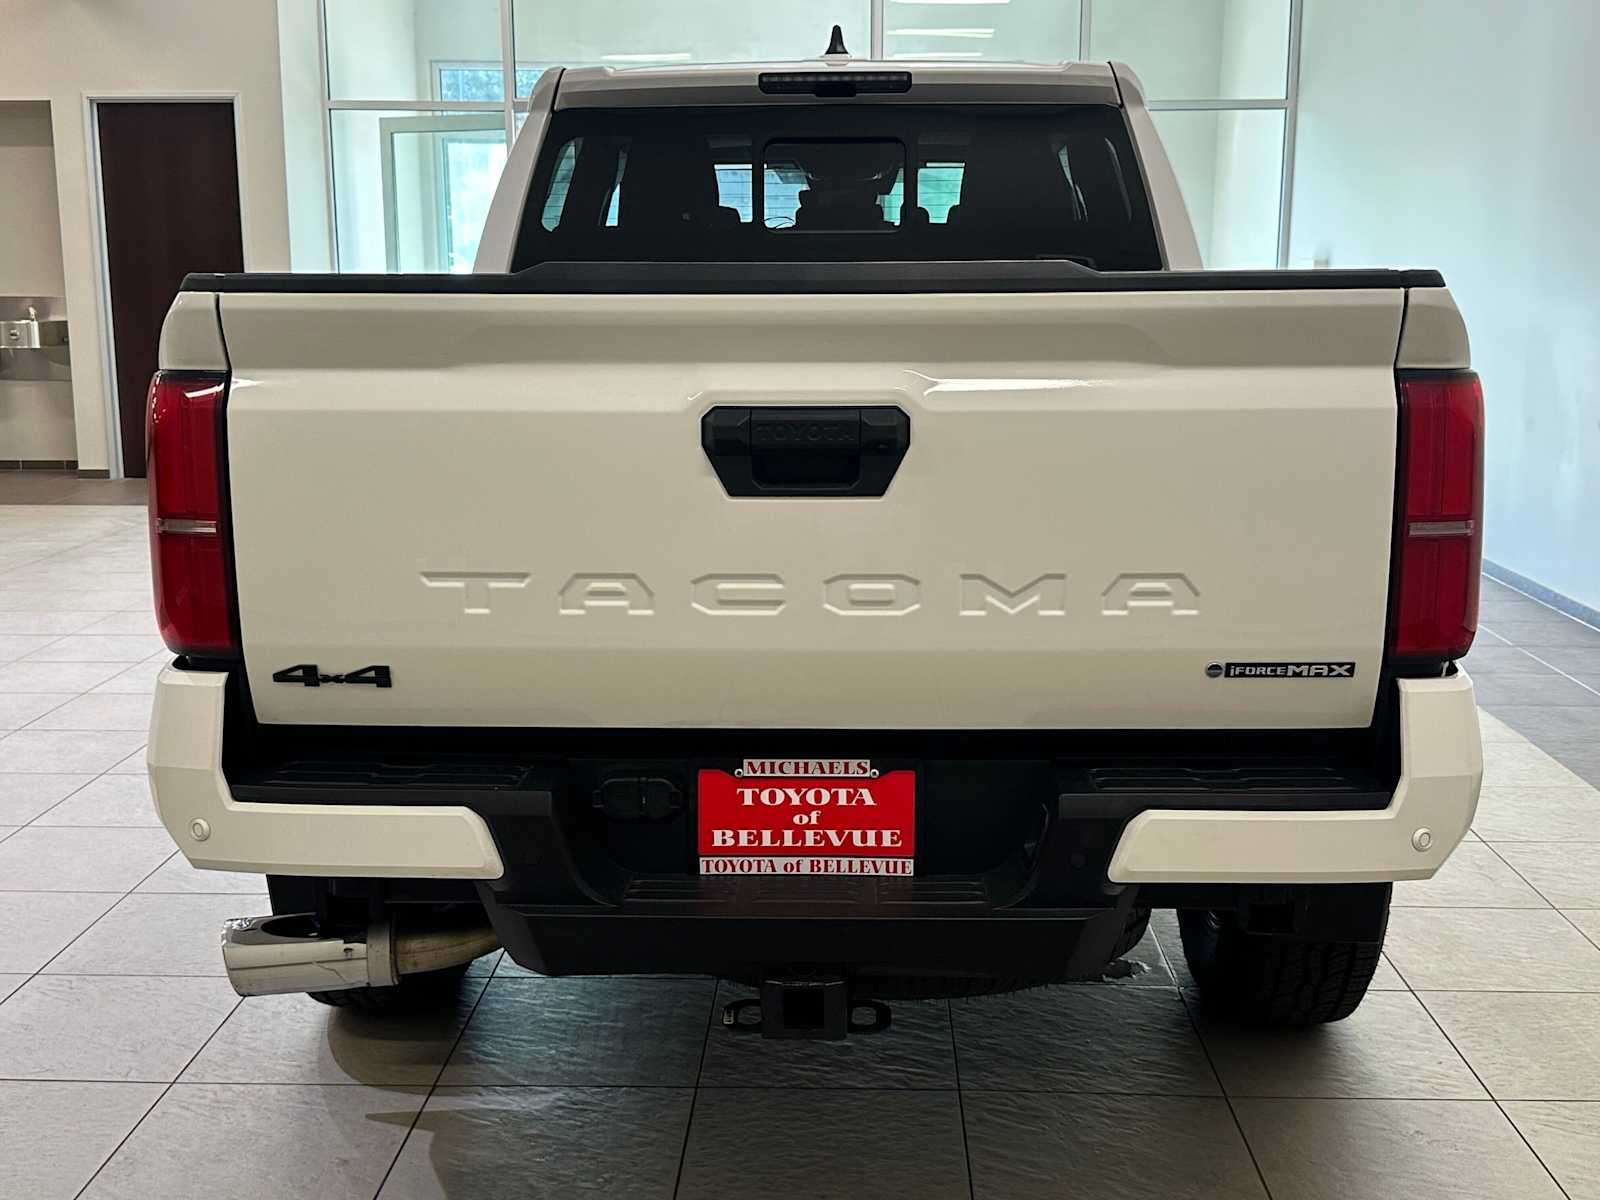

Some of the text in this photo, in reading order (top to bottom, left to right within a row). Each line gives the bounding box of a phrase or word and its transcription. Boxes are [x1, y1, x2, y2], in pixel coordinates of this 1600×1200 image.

[756, 423, 855, 441] TOYOTA
[420, 572, 1201, 616] TACOMA
[746, 761, 869, 775] MICHAELS
[737, 788, 876, 806] TOYOTA
[792, 810, 822, 825] of
[711, 829, 902, 847] BELLEVUE
[701, 859, 912, 875] TOYOTA of BELLEVUE
